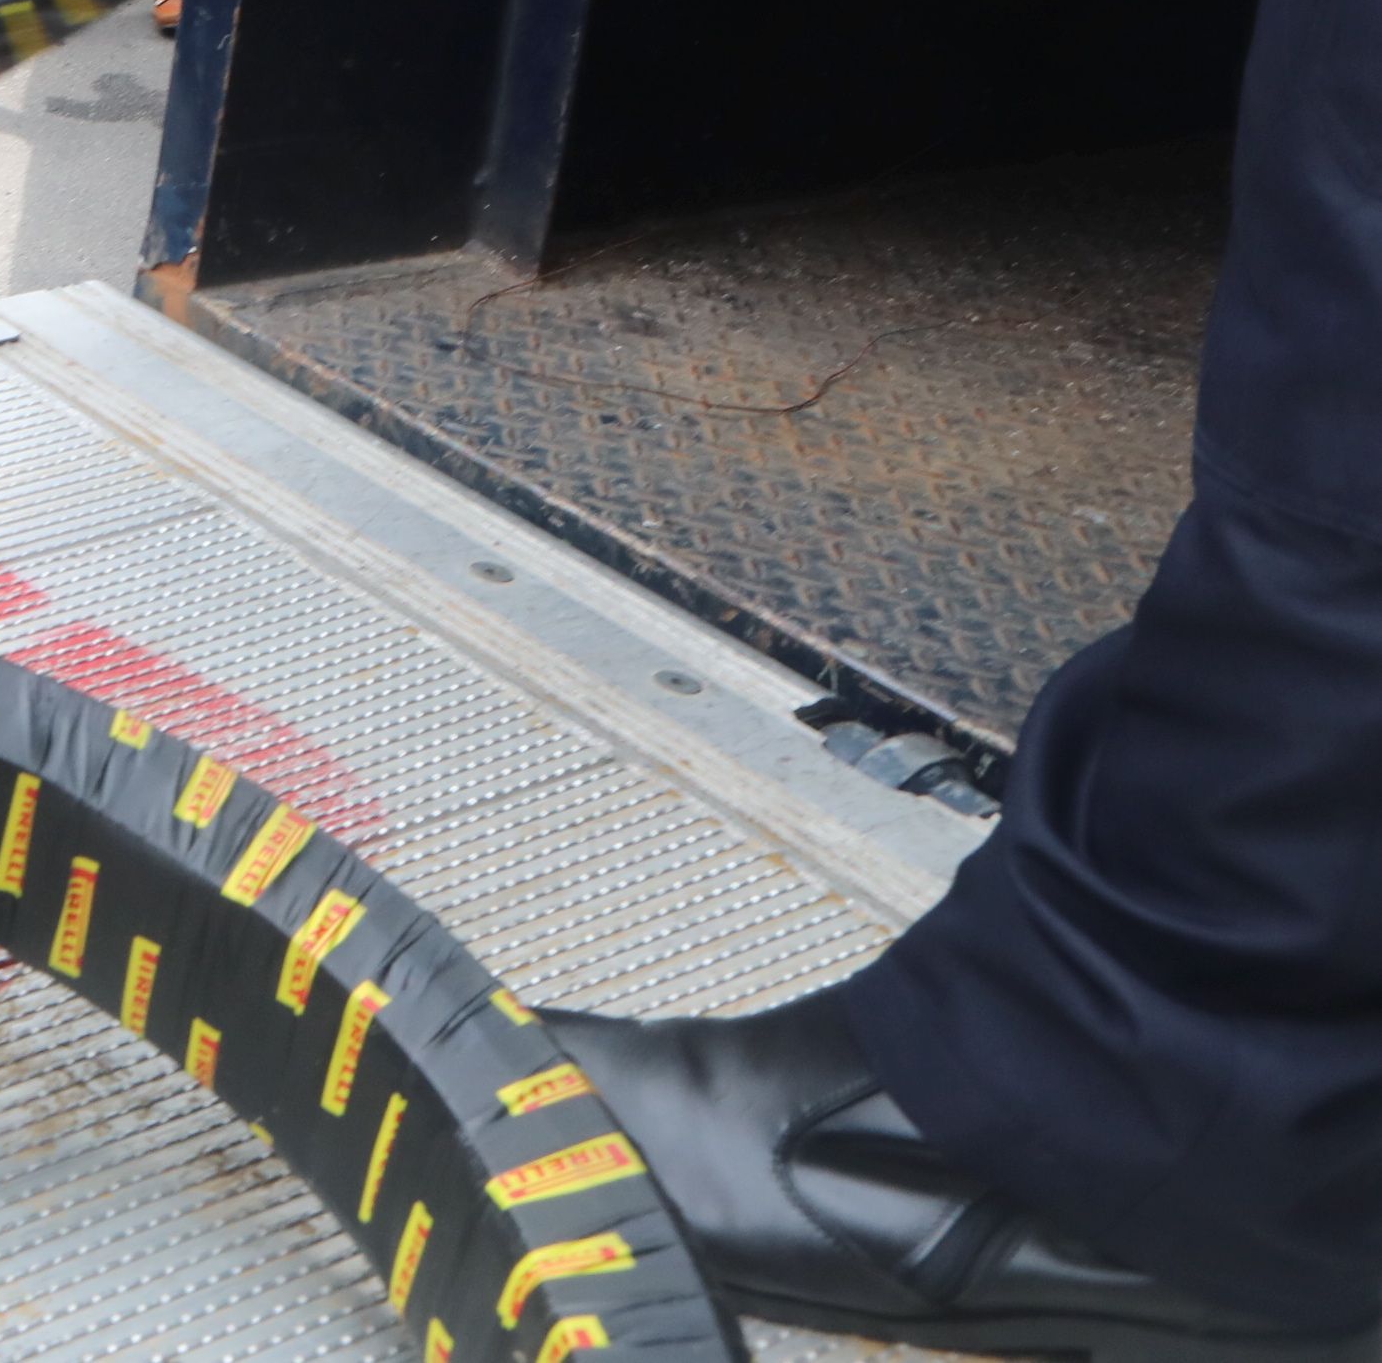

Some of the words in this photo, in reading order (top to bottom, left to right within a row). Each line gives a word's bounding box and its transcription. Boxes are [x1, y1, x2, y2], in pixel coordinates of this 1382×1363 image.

[61, 866, 99, 969] PIRELLI
[334, 995, 380, 1107] PIRELLI
[497, 1141, 631, 1200] PIRELLI
